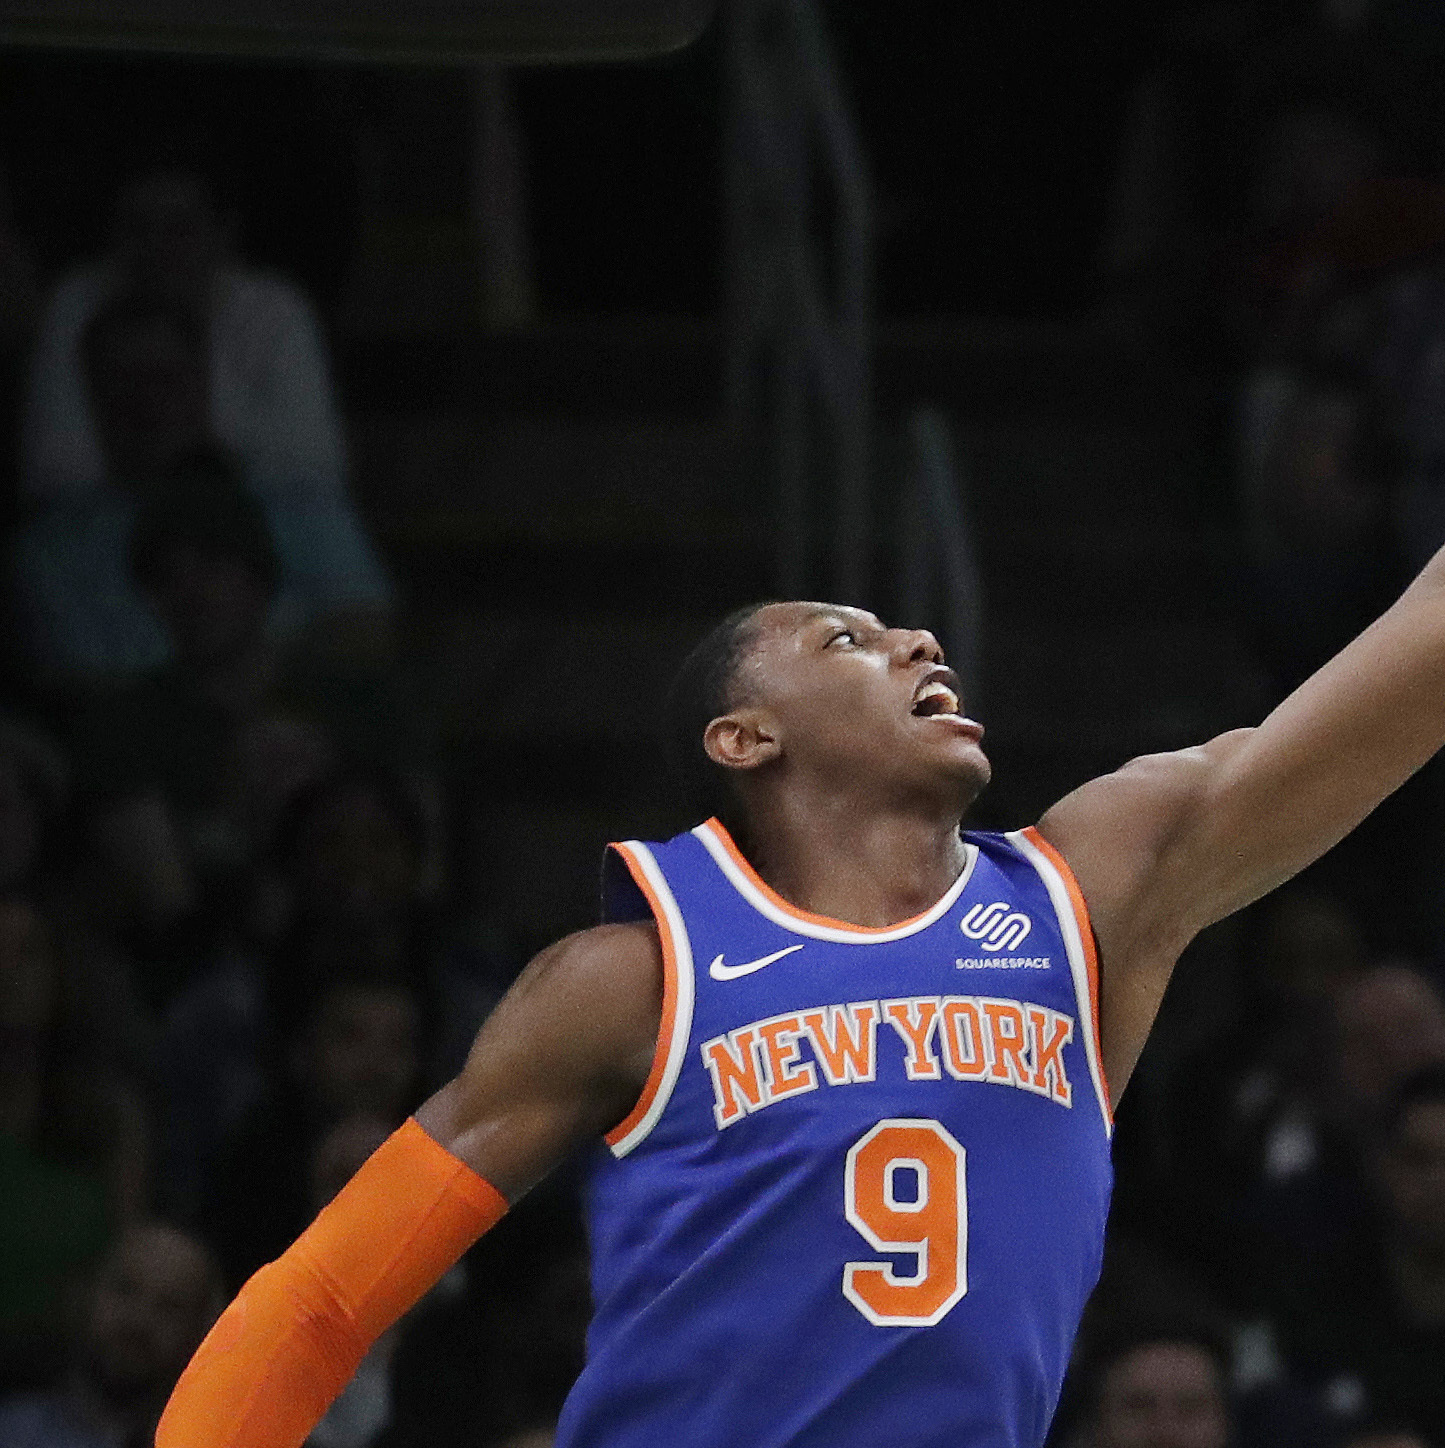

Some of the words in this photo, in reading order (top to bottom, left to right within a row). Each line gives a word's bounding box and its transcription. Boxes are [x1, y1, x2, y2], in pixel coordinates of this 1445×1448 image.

[955, 957, 1051, 970] SQUARESPACE
[701, 1000, 877, 1130] NEW
[882, 995, 1074, 1108] YORK
[842, 1118, 968, 1327] 9
